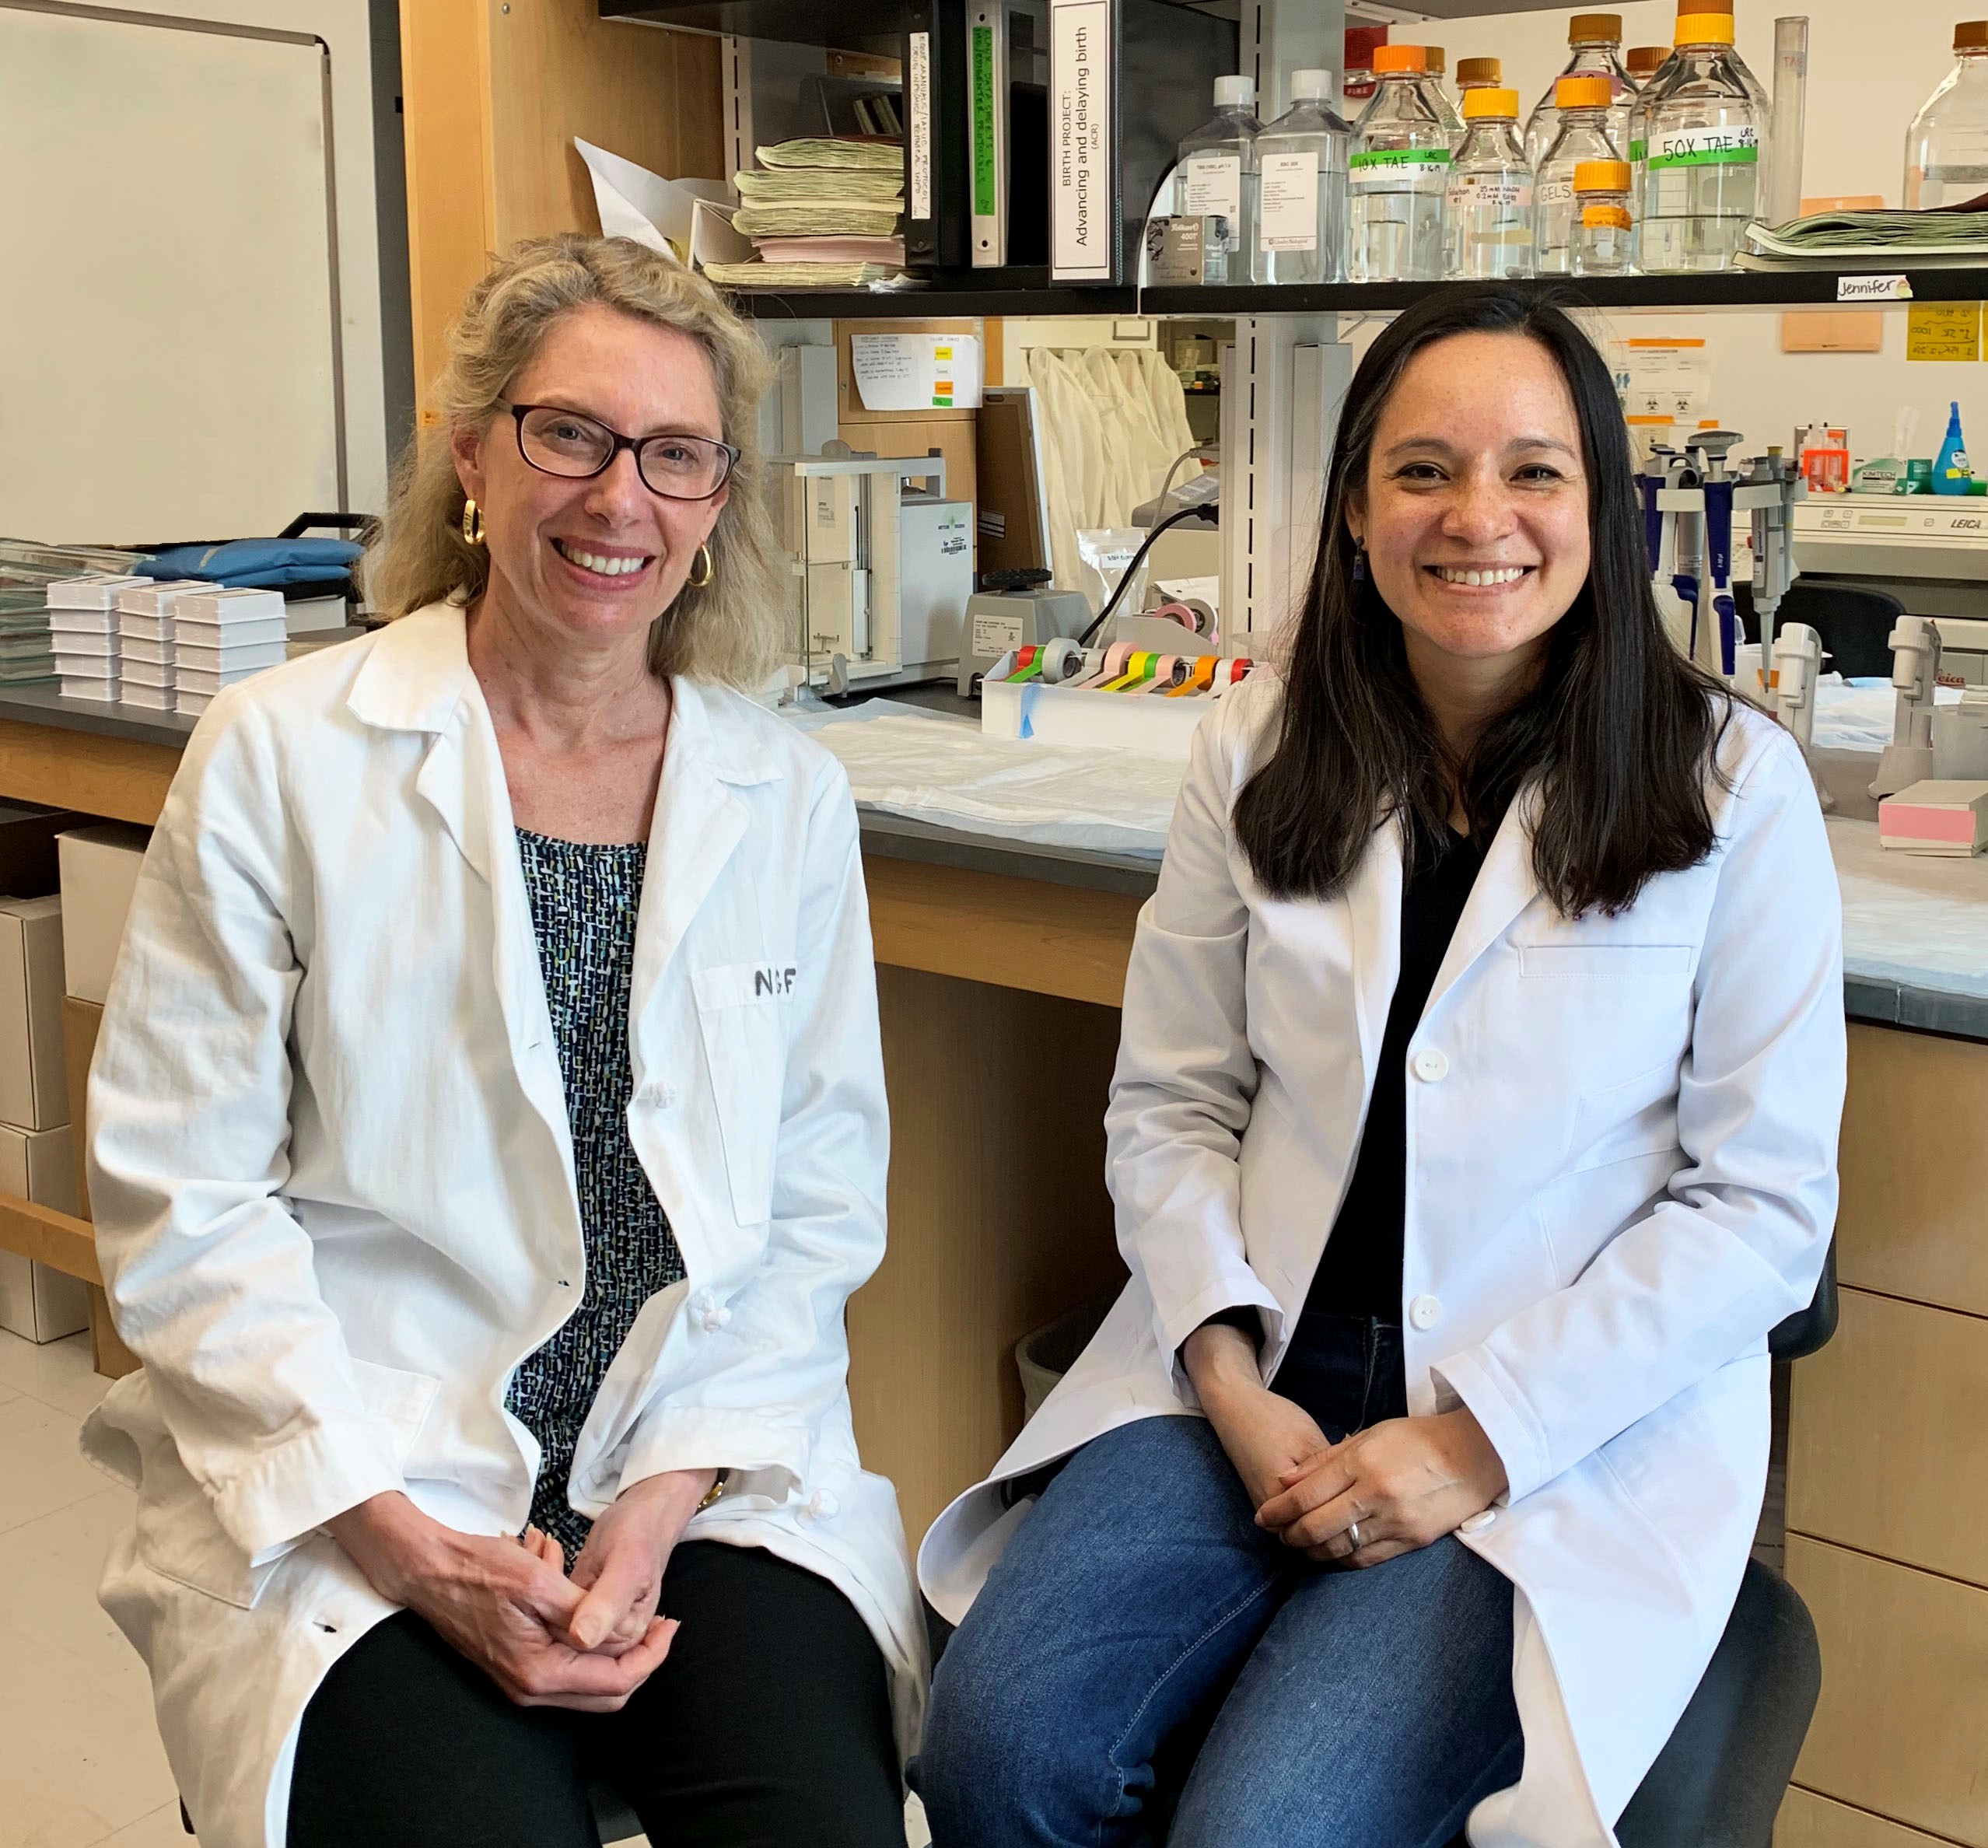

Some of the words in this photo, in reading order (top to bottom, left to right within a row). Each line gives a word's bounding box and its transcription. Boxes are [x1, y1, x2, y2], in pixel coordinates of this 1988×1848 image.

[1076, 26, 1087, 61] birth
[1076, 68, 1090, 130] delaying
[1347, 86, 1368, 95] FIRE
[1062, 90, 1071, 145] PROJECT:
[1090, 124, 1099, 149] (ACR)
[1663, 138, 1697, 162] 50X
[1703, 135, 1733, 153] TAE
[1076, 137, 1087, 163] and
[1062, 150, 1071, 187] BIRTH
[1359, 157, 1377, 173] 10X
[1383, 156, 1410, 169] TAE
[1447, 187, 1470, 196] Solution
[1540, 184, 1572, 202] GELS
[1076, 170, 1090, 246] Advancing
[1838, 279, 1896, 297] Jennifer
[1951, 519, 1981, 529] LEICA
